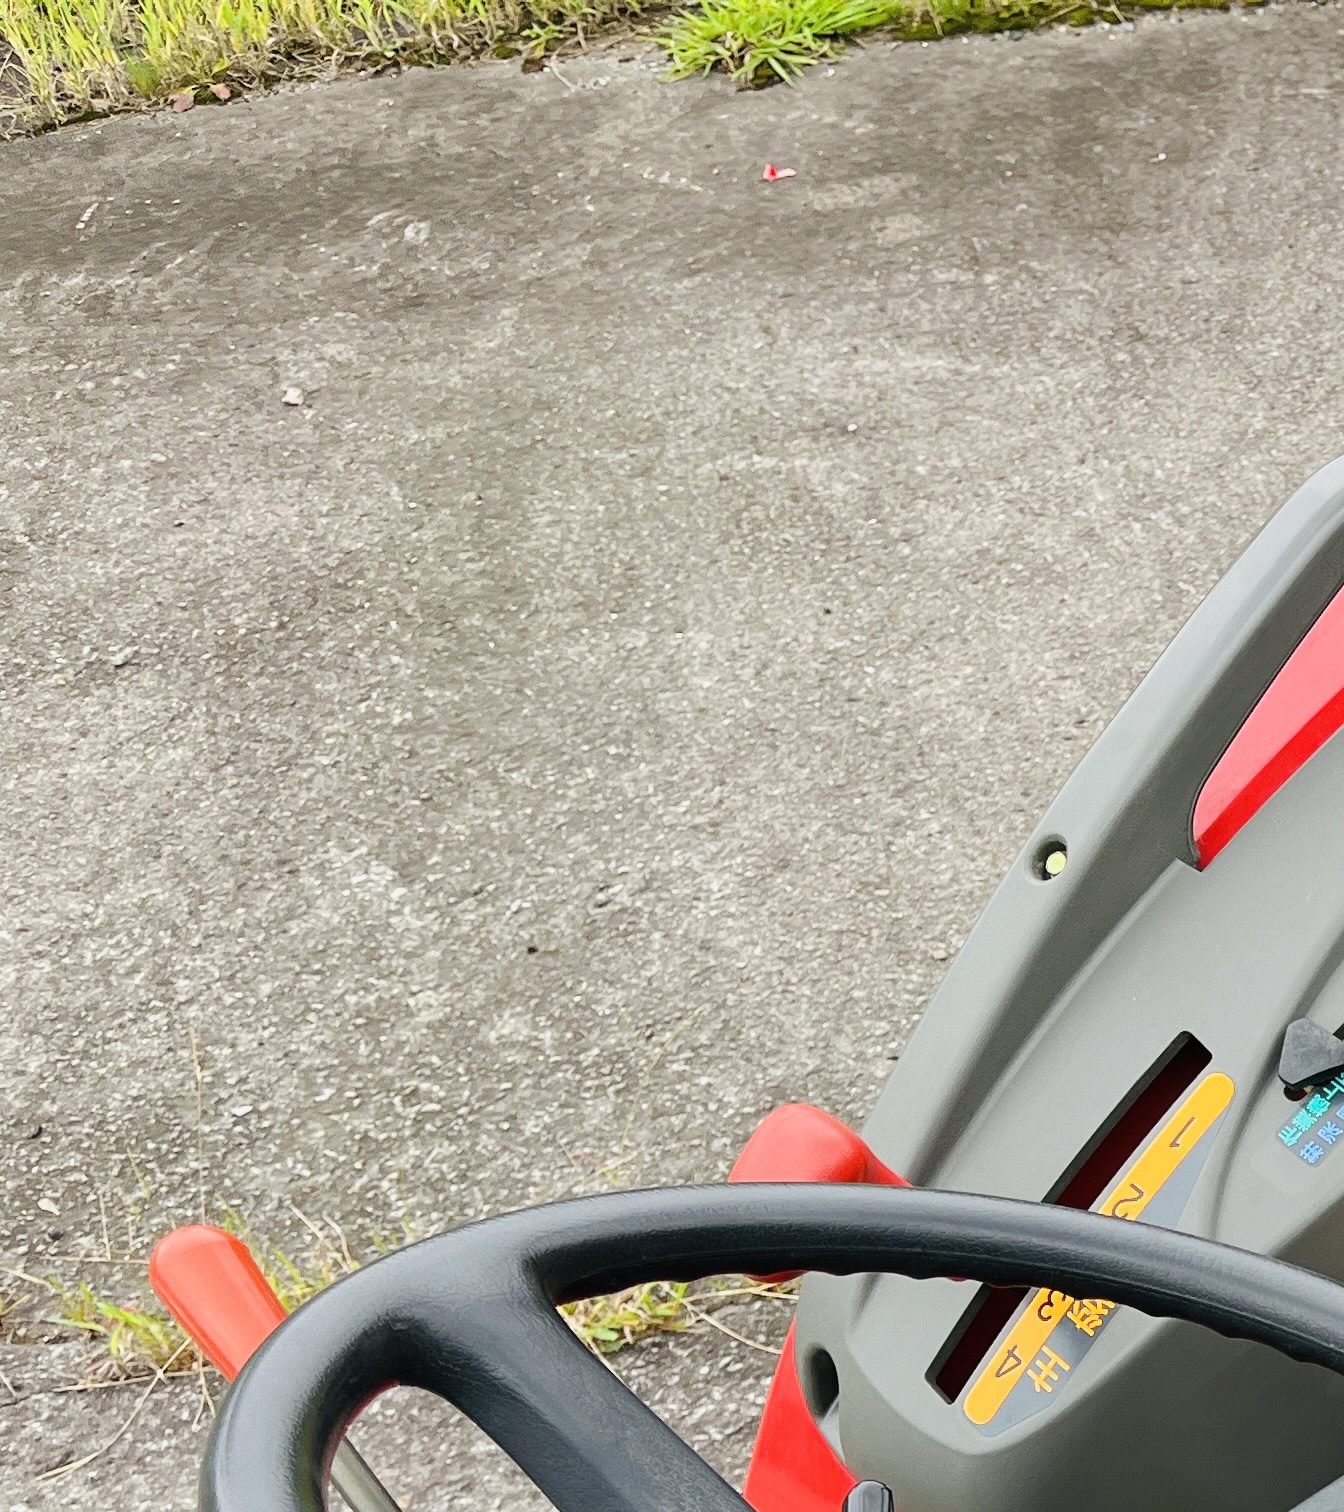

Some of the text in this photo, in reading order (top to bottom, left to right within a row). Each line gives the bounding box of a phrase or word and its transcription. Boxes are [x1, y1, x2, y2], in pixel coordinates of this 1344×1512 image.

[1169, 1117, 1195, 1147] 1
[1111, 1184, 1144, 1220] 2
[996, 1346, 1021, 1377] 4
